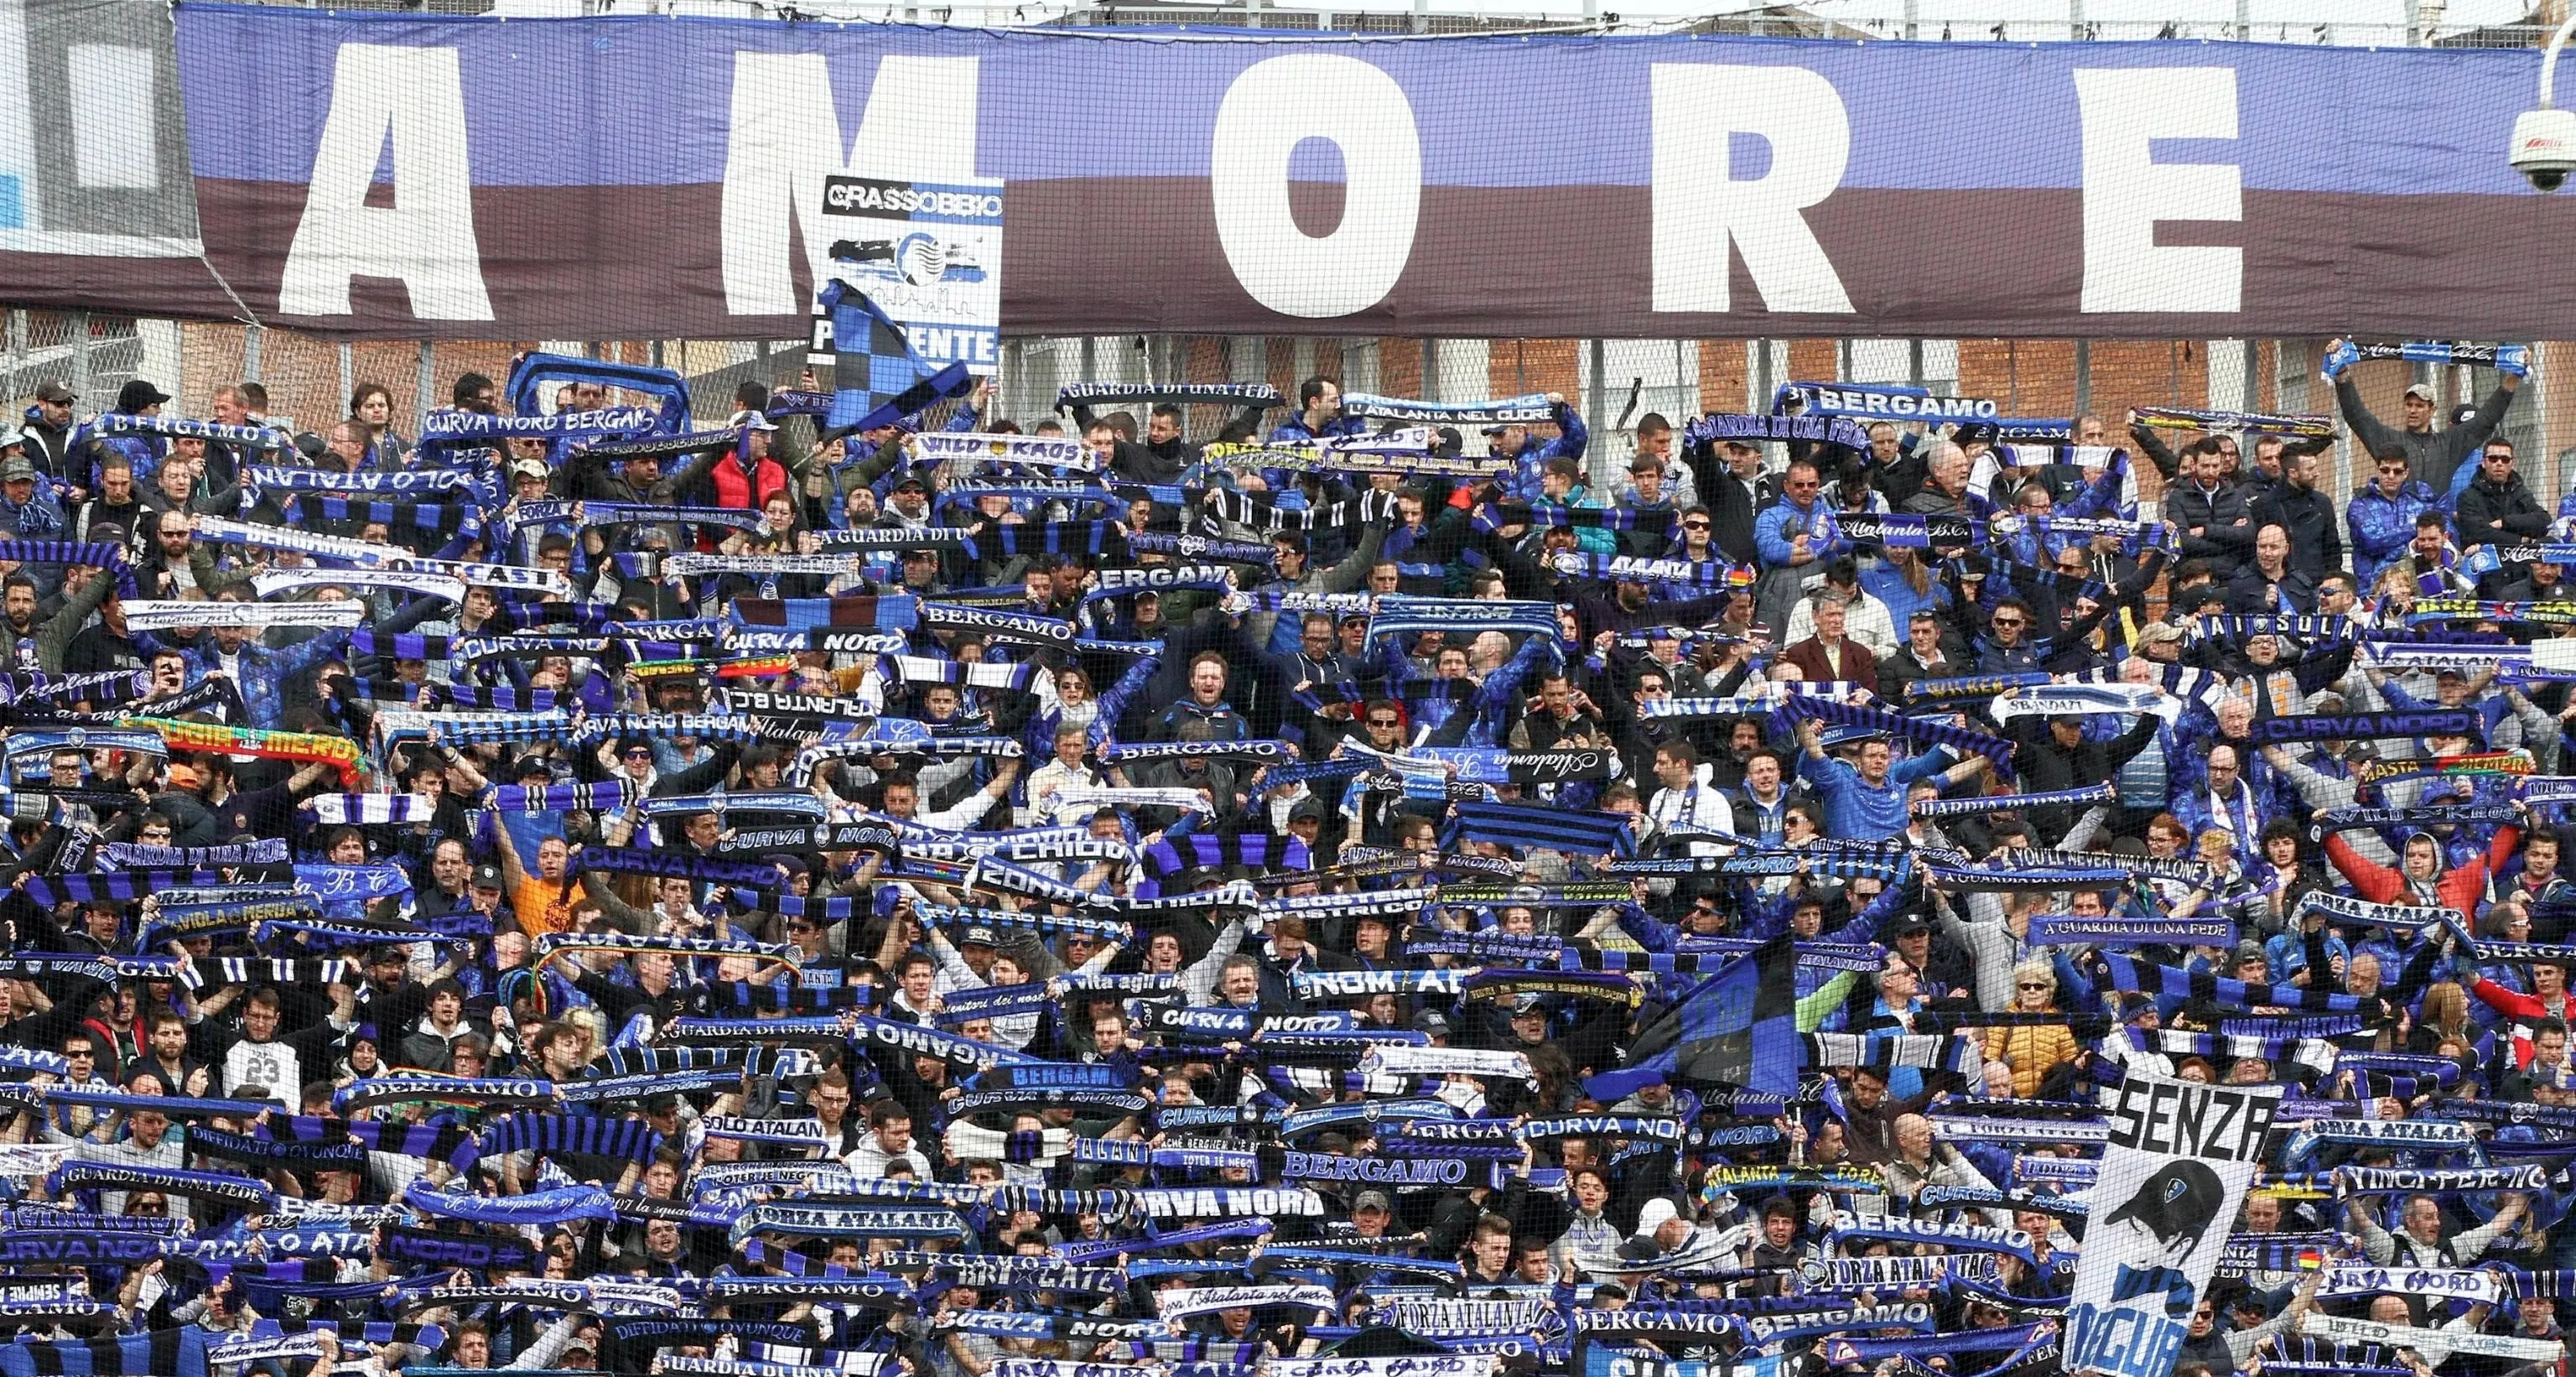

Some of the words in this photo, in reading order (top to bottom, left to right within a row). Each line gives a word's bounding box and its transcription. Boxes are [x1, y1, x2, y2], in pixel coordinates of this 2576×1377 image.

[828, 184, 1003, 217] GRASSOBBIO
[813, 320, 996, 361] PENTE
[1067, 383, 1156, 401] GUARDIA
[1349, 404, 1450, 420] L'ATALANTA
[1457, 408, 1491, 420] NEL
[1497, 407, 1552, 420] CUORE
[1819, 392, 1997, 418] BERGAMO
[113, 415, 260, 441] BERGAMO
[426, 414, 490, 433] CURVA
[498, 413, 558, 433] NORD
[924, 436, 982, 455] WILD
[1012, 440, 1079, 459] KAOS
[518, 501, 562, 518] FORZA
[837, 528, 926, 543] GUARDIA
[1842, 519, 1923, 538] Atalanta
[1931, 523, 1968, 538] B.C.
[1609, 555, 1692, 574] ATALANTA
[928, 608, 1072, 642] BERGAMO
[464, 637, 553, 661] CURVA
[724, 632, 806, 652] CURVA
[824, 631, 903, 652] NORD
[14, 668, 145, 703] Atalanta
[626, 715, 677, 732] NORD
[2266, 717, 2376, 740] CURVA
[2381, 712, 2470, 735] NORD
[1121, 740, 1277, 759] BERGAMO
[1493, 751, 1600, 779] Atalanta
[2528, 782, 2573, 796] 100%
[719, 827, 806, 850] CURVA
[582, 848, 691, 875] CURVA
[694, 860, 779, 886] NORD
[1721, 855, 1800, 874] NORD
[2016, 848, 2065, 869] YOU'LL
[2068, 850, 2112, 870] NEVER
[2115, 852, 2153, 875] WALK
[2152, 856, 2205, 882] ALONE
[2045, 922, 2055, 936] A
[2059, 920, 2128, 935] GUARDIA
[2134, 922, 2150, 935] DI
[2153, 922, 2184, 936] UNA
[2189, 922, 2227, 938] FEDE
[1078, 974, 1114, 990] vita
[1118, 972, 1155, 994] agli
[671, 1023, 747, 1038] GUARDIA
[1162, 1009, 1246, 1031] CURVA
[1262, 1015, 1343, 1034] NORD
[245, 1058, 280, 1083] 23
[365, 1081, 538, 1099] BERGAMO
[947, 1090, 1037, 1115] CURVA
[701, 1115, 748, 1134] SOLO
[752, 1117, 823, 1138] ATALAN
[1159, 1105, 1238, 1130] CURVA
[1529, 1116, 1622, 1138] CURVA
[2109, 1080, 2275, 1161] SENZA
[1709, 1124, 1779, 1146] NORD
[1282, 1151, 1467, 1183] BERGAMO
[68, 1167, 148, 1184] GUARDIA
[178, 1176, 216, 1194] UNA
[220, 1182, 262, 1204] FEDE
[1919, 1184, 2003, 1207] CURVA
[1228, 1188, 1325, 1218] NORD
[750, 1206, 828, 1227] FORZA
[836, 1210, 961, 1229] ATALANTA
[1836, 1208, 2032, 1249] BERGAMO
[389, 1235, 492, 1266] NORD
[883, 1250, 1040, 1270] BERGAMO
[1830, 1259, 1884, 1286] FORZA
[10, 1284, 60, 1303] SEMPRE
[431, 1281, 582, 1302] BERGAMO
[724, 1282, 885, 1299] BERGAMO
[1398, 1301, 1449, 1326] FORZA
[1456, 1301, 1532, 1330] ATALANTA
[1576, 1312, 1731, 1335] BERGAMO
[1749, 1302, 1929, 1338] BERGAMO
[660, 1356, 756, 1377] GUARDIA
